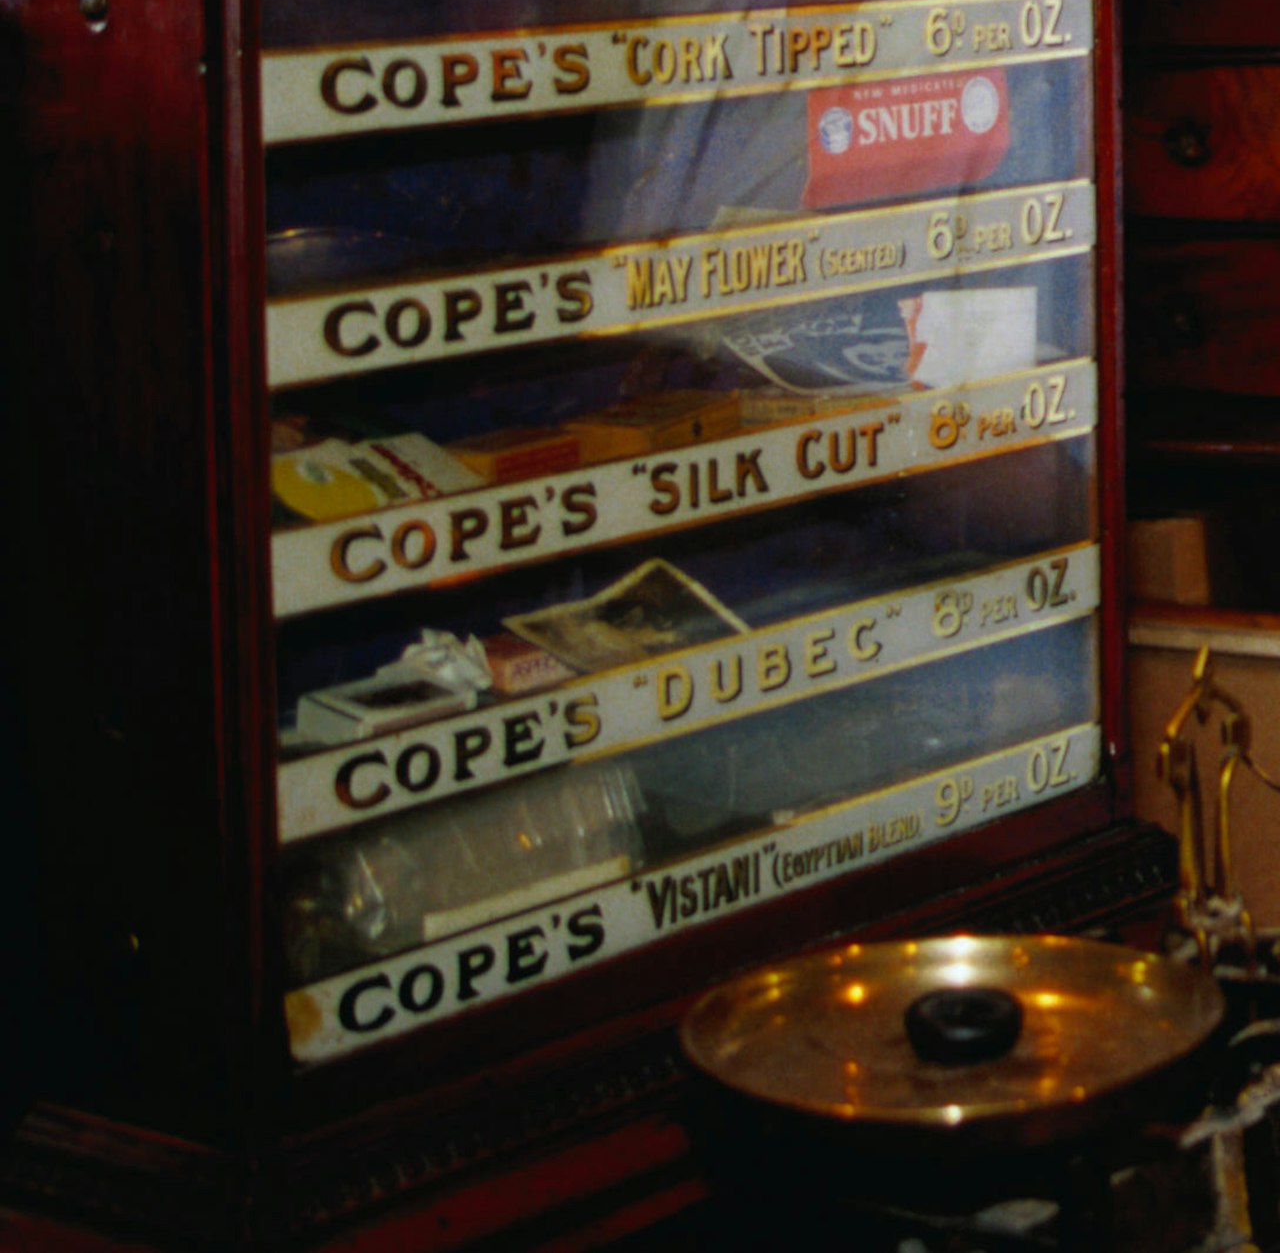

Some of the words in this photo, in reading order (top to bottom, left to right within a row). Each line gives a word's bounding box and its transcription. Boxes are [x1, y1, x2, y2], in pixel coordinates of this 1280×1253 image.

[320, 42, 592, 115] COPE'S
[972, 23, 1012, 52] PER
[857, 98, 959, 147] SNUFF
[323, 270, 594, 358] COPE'S
[817, 244, 906, 281] (SCENTED)
[974, 223, 1013, 253] PER
[329, 481, 598, 584] COPE'S
[976, 411, 1017, 440] PER
[334, 693, 603, 810] COPE'S
[978, 597, 1018, 627] PER
[338, 903, 606, 1034] COPE'S
[981, 784, 1020, 812] PER
